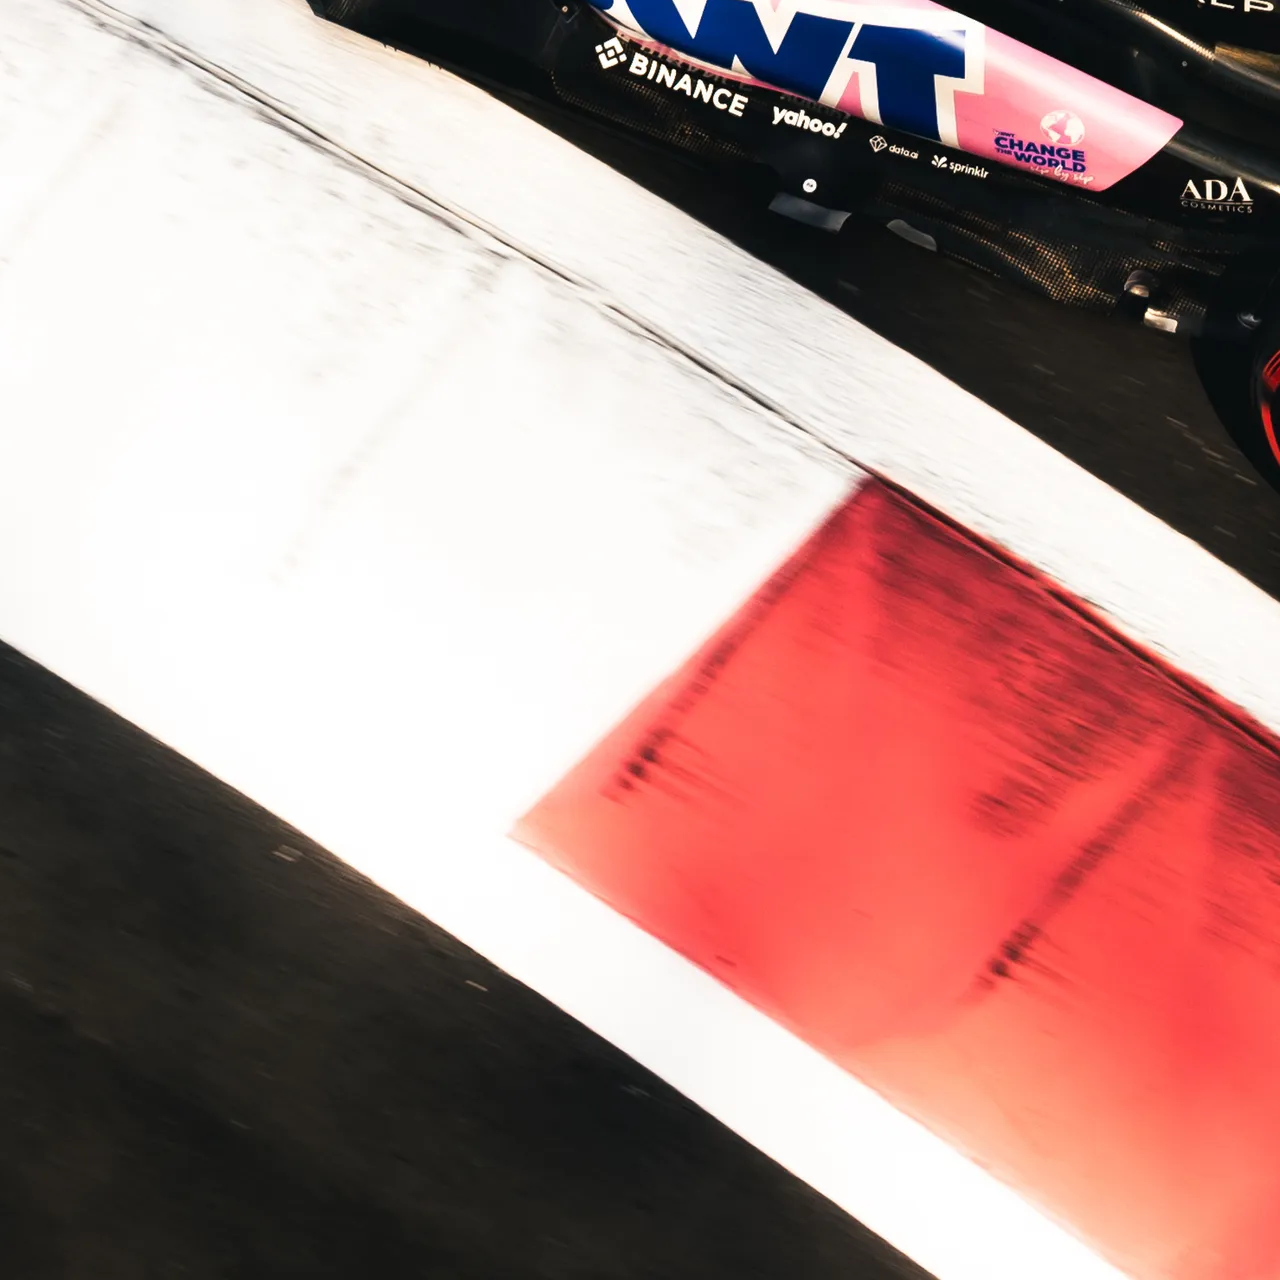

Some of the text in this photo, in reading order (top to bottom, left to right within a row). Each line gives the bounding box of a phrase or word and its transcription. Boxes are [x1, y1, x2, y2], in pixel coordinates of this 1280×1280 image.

[628, 52, 749, 117] BINANCE
[771, 106, 848, 140] yahoo!
[888, 144, 919, 159] data.ai
[994, 136, 1085, 162] CHANGE
[995, 147, 1087, 173] THE WORLD
[949, 161, 990, 179] sprinklr
[1180, 176, 1253, 202] ADA
[1181, 201, 1253, 214] COSMETICS
